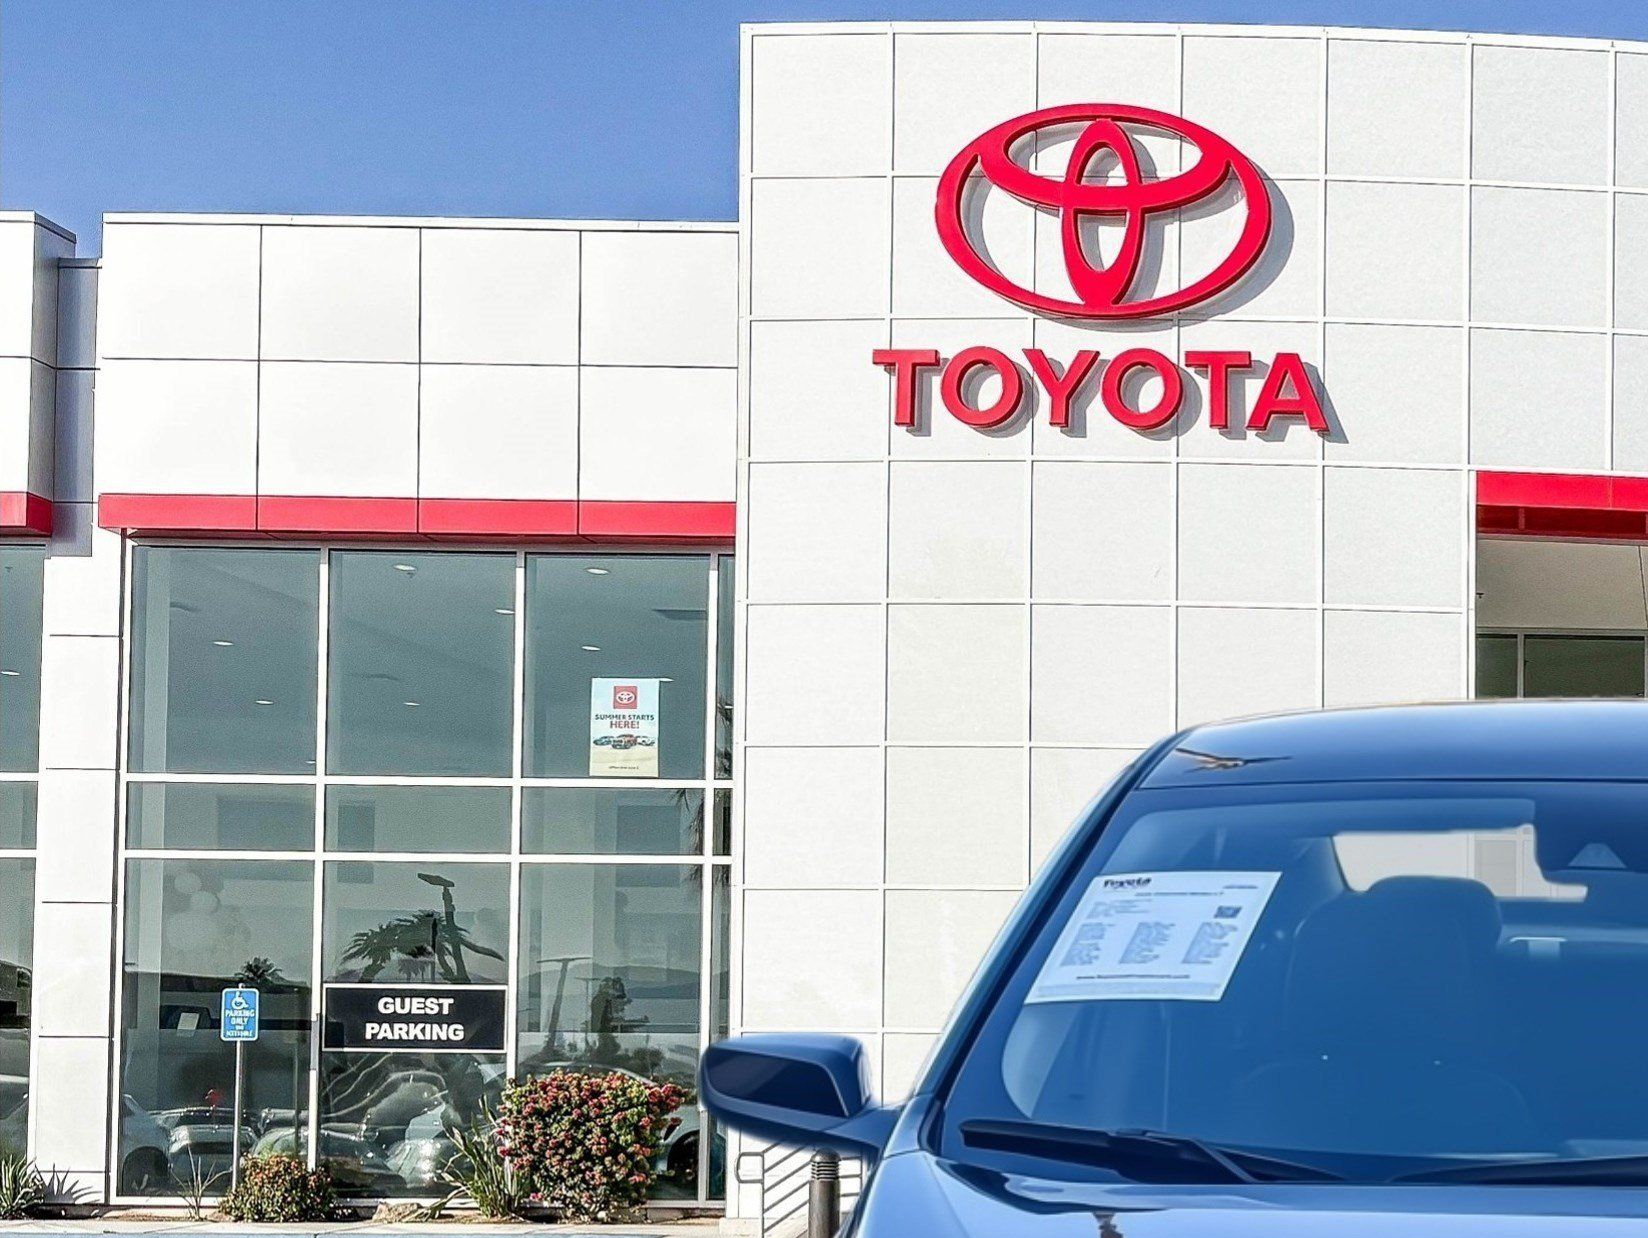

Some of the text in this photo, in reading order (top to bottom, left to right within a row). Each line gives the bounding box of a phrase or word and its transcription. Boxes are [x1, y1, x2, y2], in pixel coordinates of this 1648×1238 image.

[872, 345, 1330, 434] TOYOTA
[609, 720, 640, 729] HERE!
[377, 996, 455, 1015] GUEST
[225, 1009, 255, 1017] PARKING
[230, 1017, 249, 1025] ONLY
[365, 1022, 465, 1041] PARKING
